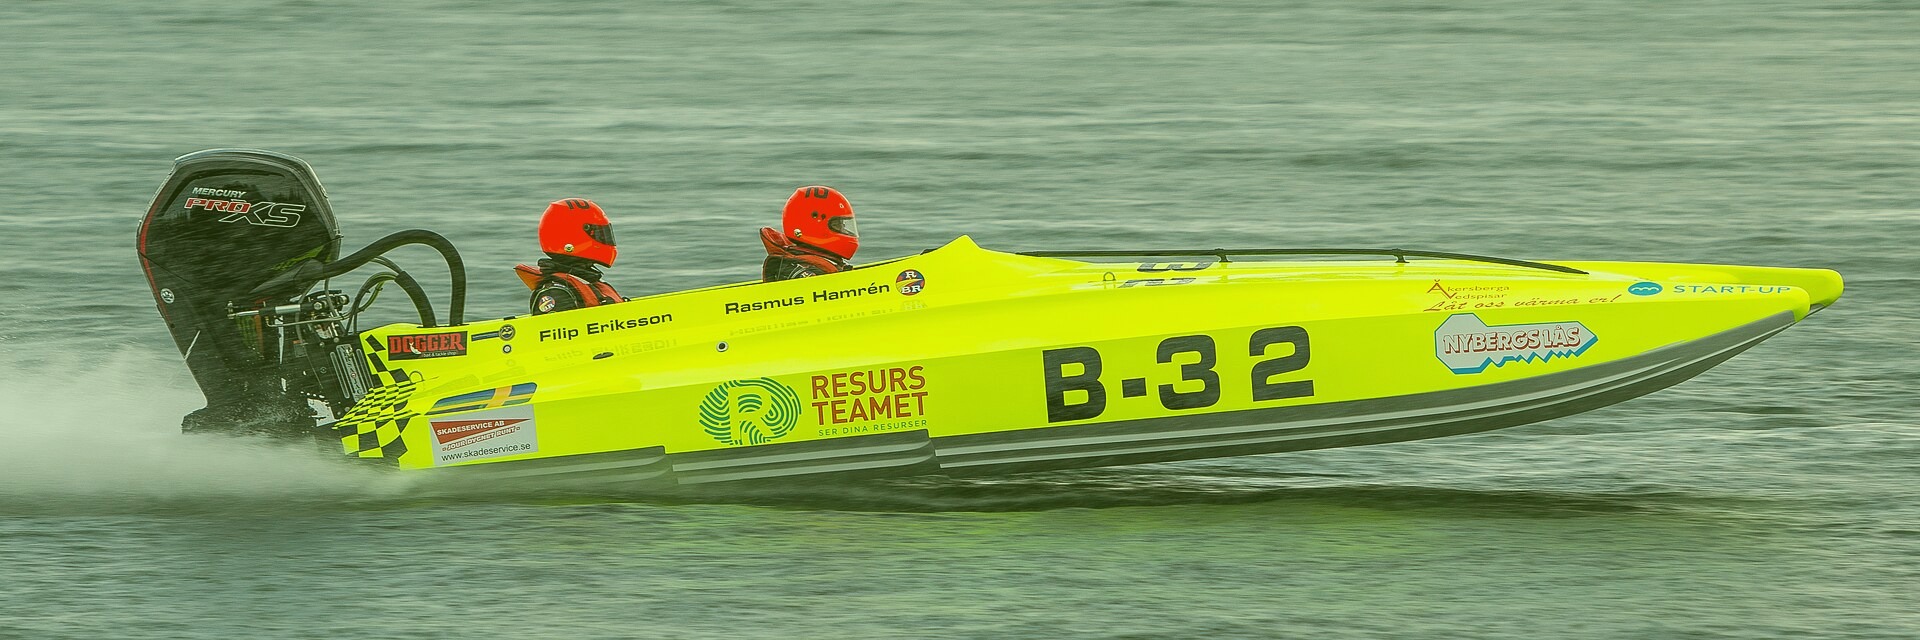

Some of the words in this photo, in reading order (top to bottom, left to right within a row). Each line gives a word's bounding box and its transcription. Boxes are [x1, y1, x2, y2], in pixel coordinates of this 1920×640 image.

[191, 187, 247, 198] MERCURY
[184, 197, 252, 214] PRO
[725, 296, 805, 315] Rasmus
[812, 282, 890, 302] Hamrén
[1673, 285, 1791, 294] START-UP
[539, 327, 579, 342] Filip
[586, 313, 673, 335] Eriksson
[389, 333, 465, 354] DOGGER
[1443, 330, 1541, 354] NYBERGS
[1542, 324, 1582, 349] LÅS
[811, 366, 926, 400] RESURS
[811, 391, 929, 426] TEAMET
[436, 421, 493, 436] SKADESERVICE
[496, 425, 516, 437] RUNT
[818, 429, 838, 437] SER
[842, 425, 869, 434] DINA
[873, 419, 928, 431] RESURSER
[441, 443, 531, 462] www.skadeservice.se
